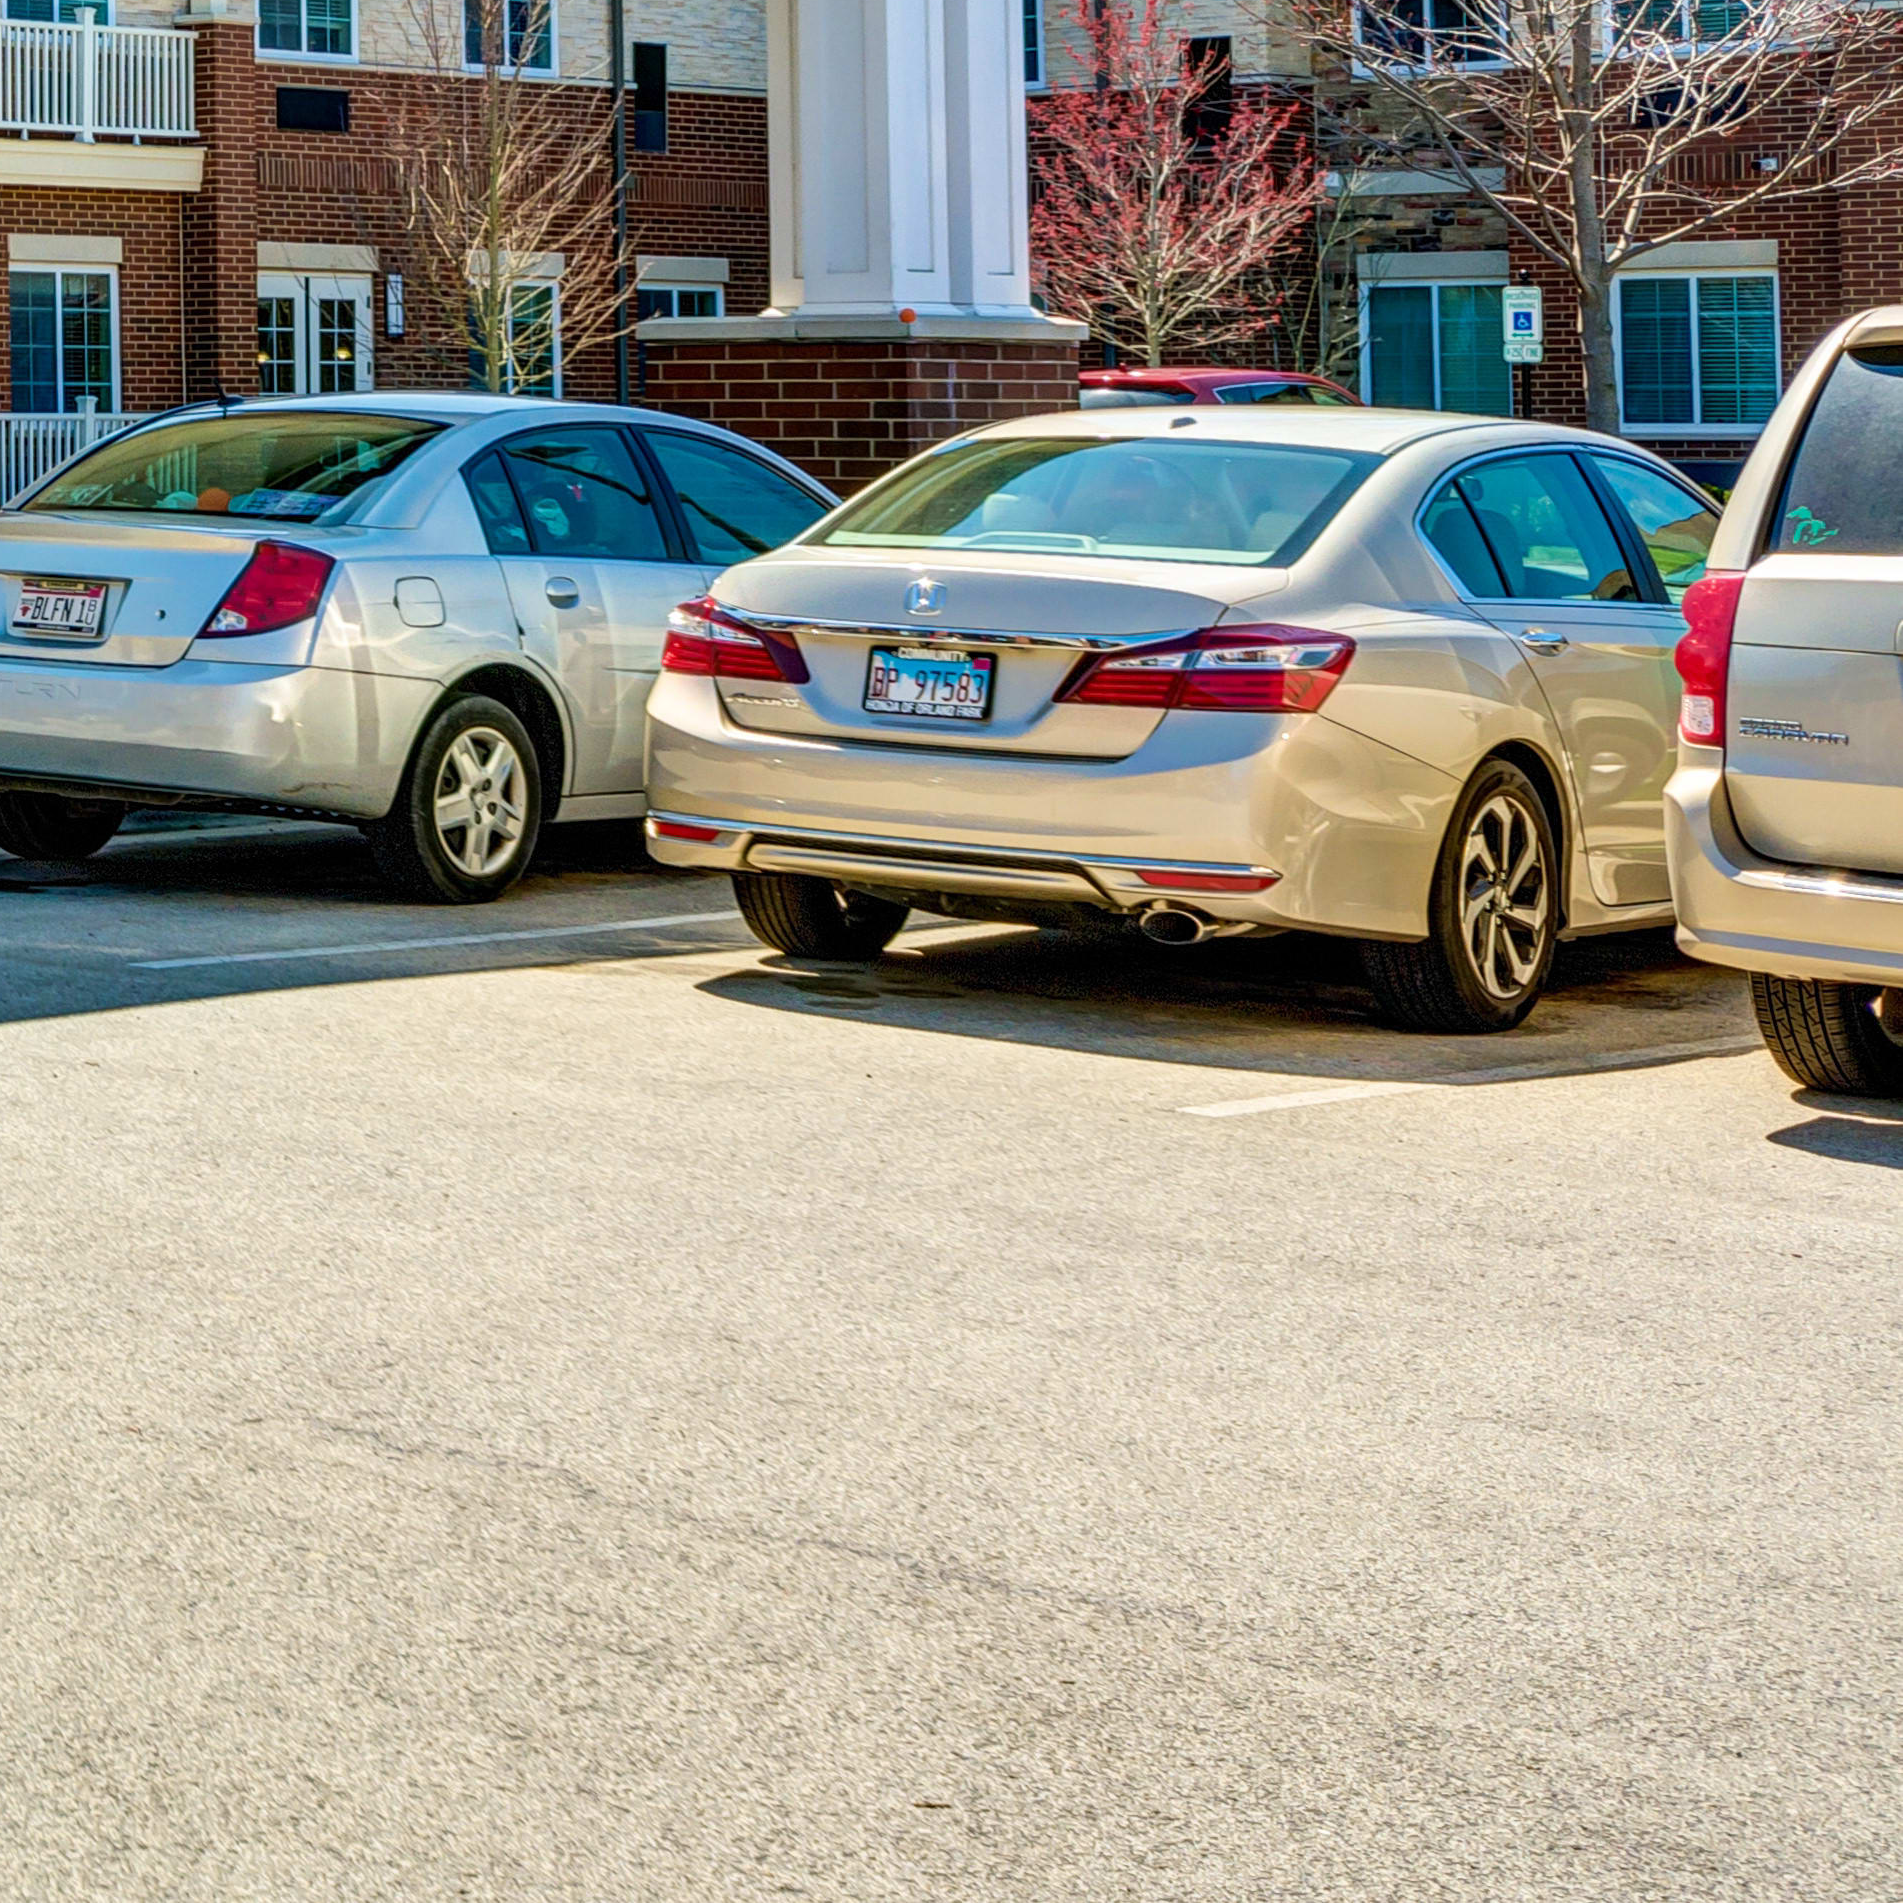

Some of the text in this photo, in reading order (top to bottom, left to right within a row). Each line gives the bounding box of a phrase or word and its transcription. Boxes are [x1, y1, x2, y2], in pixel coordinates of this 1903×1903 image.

[30, 596, 86, 624] BLFN 1
[871, 666, 985, 704] BP 97583
[865, 699, 900, 713] HONDA
[901, 702, 914, 714] OF
